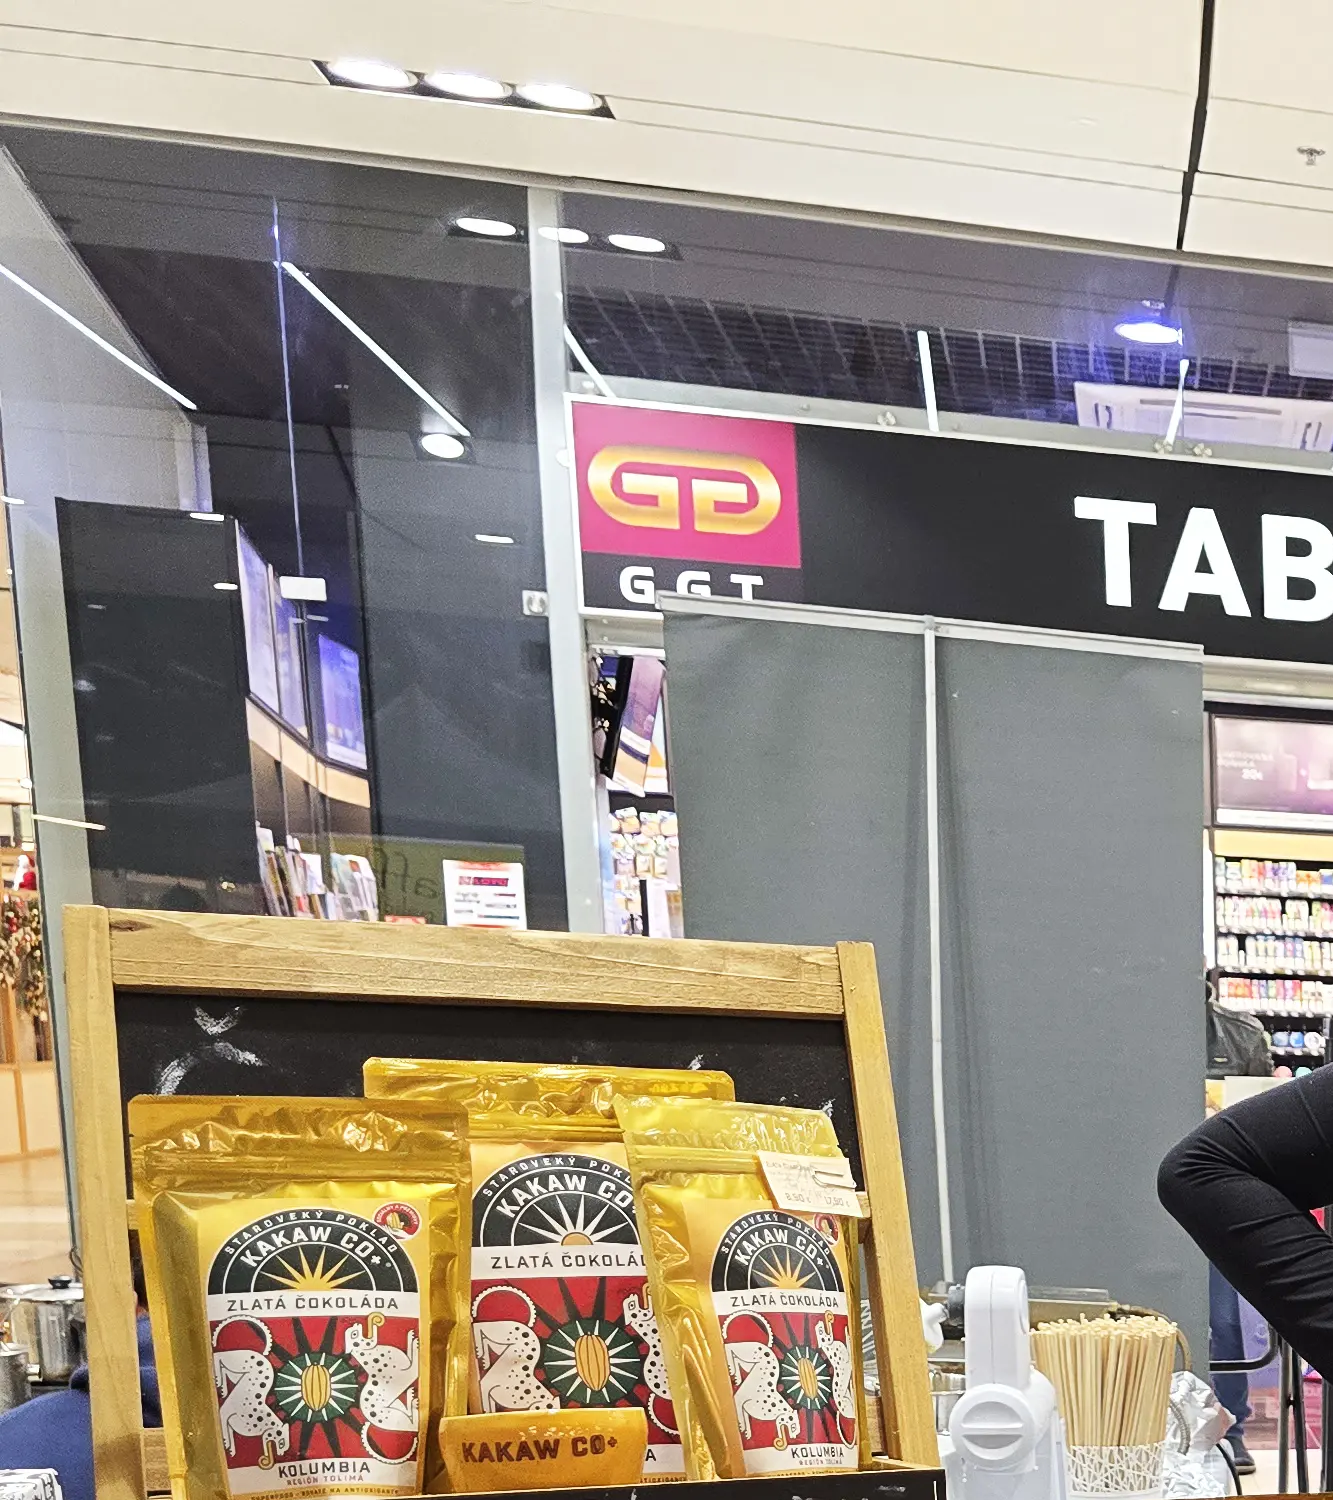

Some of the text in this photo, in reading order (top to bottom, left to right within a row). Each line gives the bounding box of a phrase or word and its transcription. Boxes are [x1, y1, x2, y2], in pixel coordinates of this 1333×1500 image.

[482, 1156, 576, 1197] STAROVEKÝ
[496, 1173, 587, 1218] KAKAW
[224, 1209, 323, 1255] STAROVEKÝ
[335, 1213, 398, 1253] POKLAD
[240, 1226, 332, 1267] KAKAW
[720, 1212, 779, 1256] STAROVEKÝ
[734, 1228, 789, 1266] KAKAW
[490, 1252, 553, 1270] ZLATÁ
[227, 1294, 399, 1312] ZLATÁ ČOKOLÁDA
[730, 1293, 840, 1308] ZLATÁ ČOKOLÁDA
[462, 1438, 560, 1463] KAKAW
[790, 1446, 845, 1460] KOLUMBIA
[278, 1461, 371, 1479] KOLUMBIA
